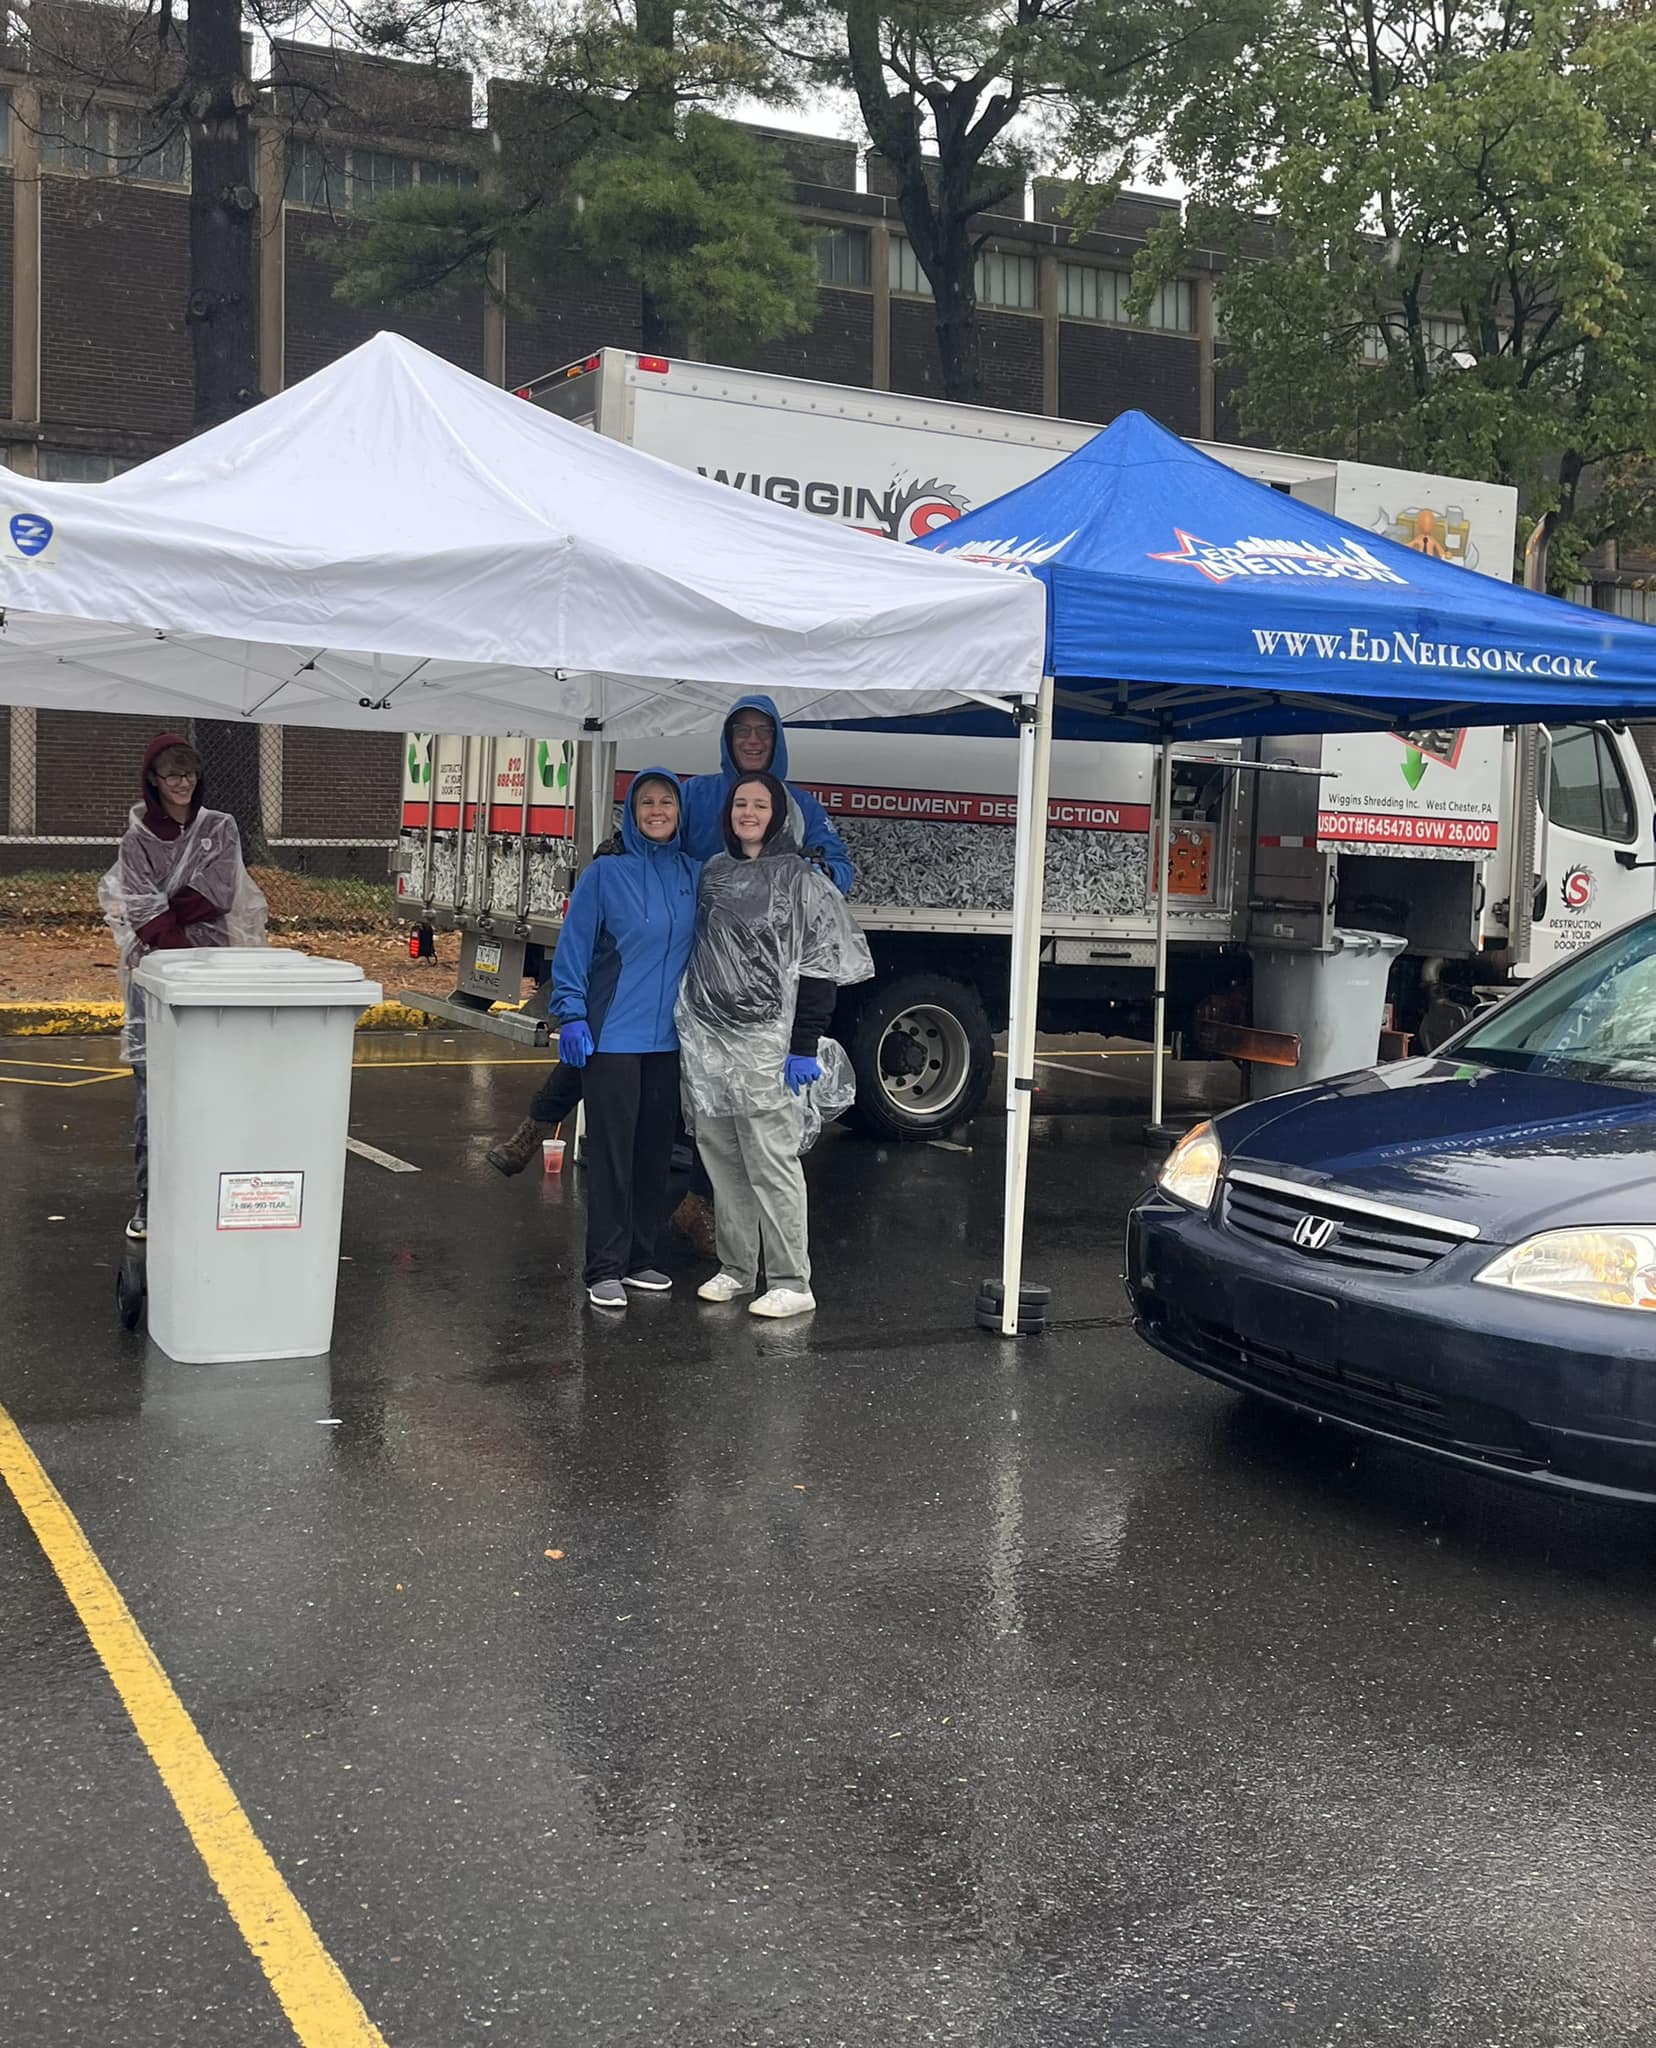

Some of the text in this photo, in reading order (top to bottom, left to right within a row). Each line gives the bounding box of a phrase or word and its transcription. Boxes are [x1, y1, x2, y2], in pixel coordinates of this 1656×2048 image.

[1201, 558, 1409, 584] NEILSON
[851, 794, 971, 816] DOCUMENT
[980, 801, 1120, 825] DESUCTION
[1328, 793, 1492, 814] Wiggins Shredding Inc. West Chester, PA
[1318, 815, 1490, 844] USDOT#1645478 GVW 26,000
[1568, 873, 1590, 905] S
[1550, 919, 1602, 929] DESTRUCTION
[1561, 930, 1591, 940] AT YOUR
